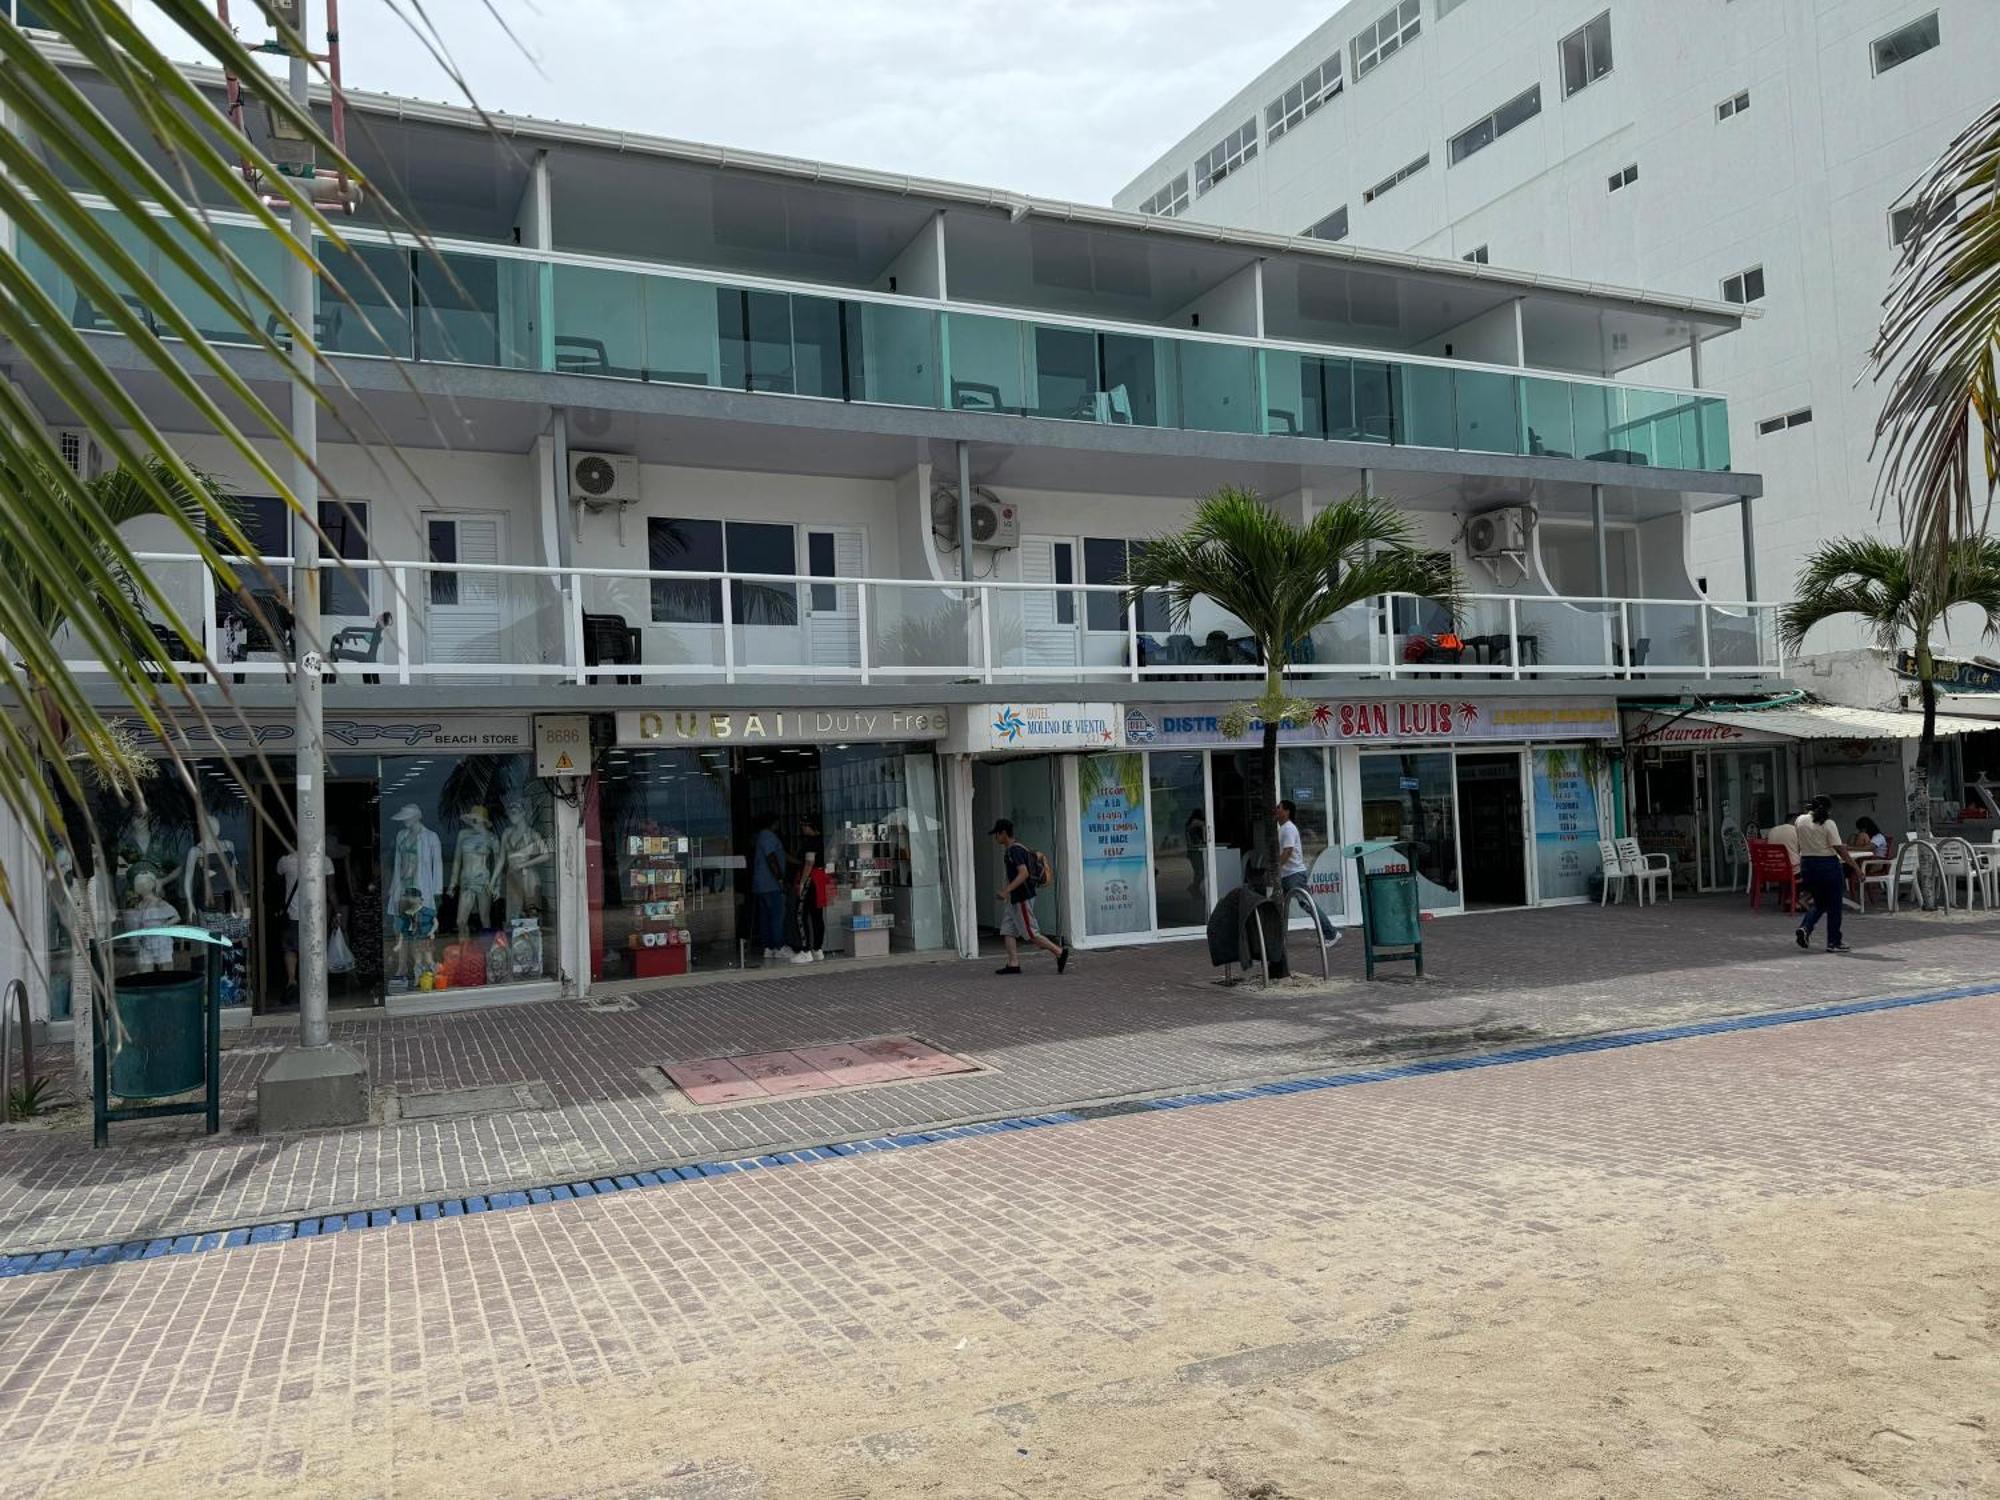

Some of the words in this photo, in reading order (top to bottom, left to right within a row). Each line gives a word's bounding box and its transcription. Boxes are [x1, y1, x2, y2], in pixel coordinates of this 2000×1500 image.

[1026, 707, 1048, 719] HOTEL
[1339, 703, 1389, 737] SAN
[1398, 702, 1454, 736] LUIS
[640, 712, 784, 739] DUBAI
[815, 711, 876, 736] Duty
[892, 711, 948, 733] Free
[1027, 720, 1060, 735] MOLINO
[1062, 720, 1073, 734] DE
[1074, 719, 1105, 734] VIENTO
[1633, 720, 1742, 745] Restaurante
[435, 735, 477, 744] BEACH
[482, 734, 519, 744] STORE
[546, 728, 580, 744] 8686
